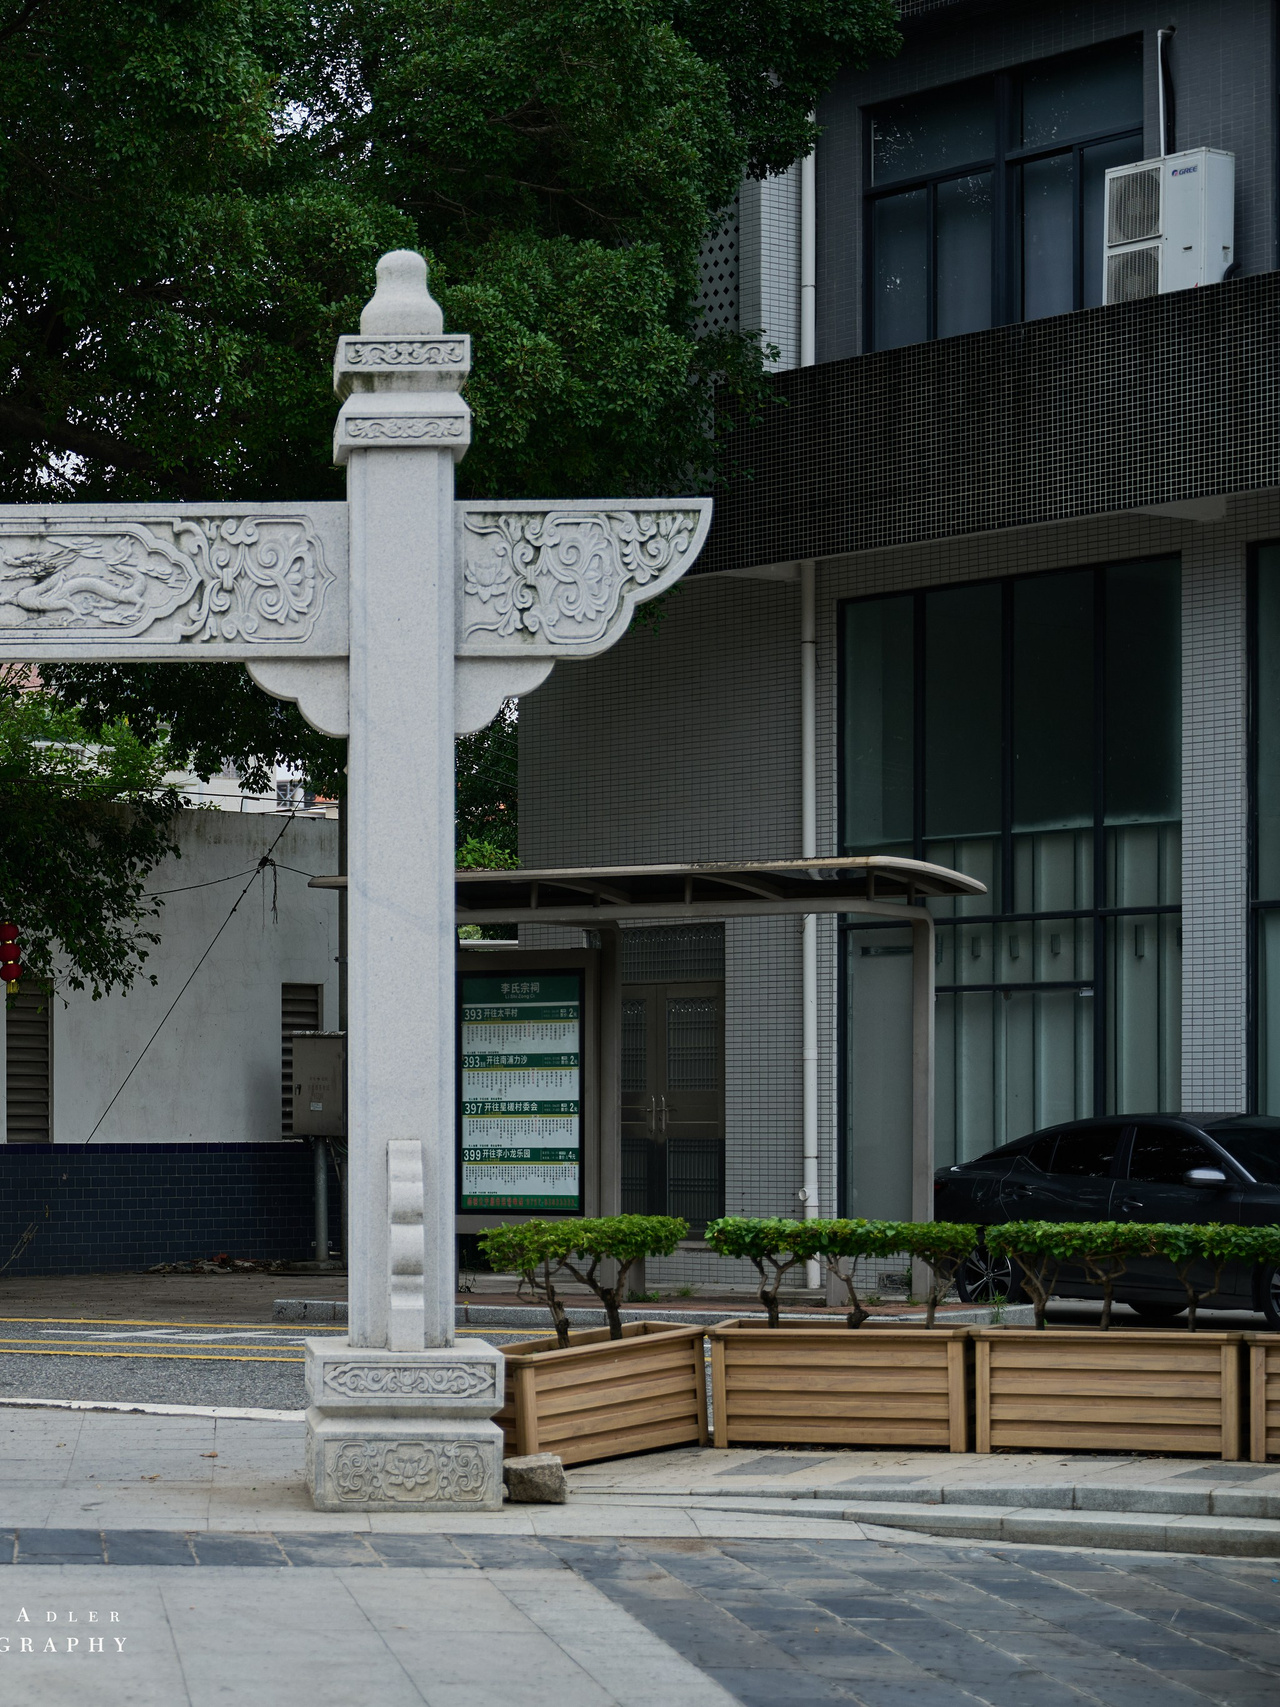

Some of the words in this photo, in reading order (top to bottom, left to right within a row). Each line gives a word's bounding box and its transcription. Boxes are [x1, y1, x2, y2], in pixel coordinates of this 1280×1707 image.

[1179, 165, 1198, 175] GREE
[500, 982, 540, 994] 李氏宗祠
[464, 1009, 482, 1020] 393
[483, 1008, 518, 1018] 开往太平村
[463, 1056, 480, 1067] 393
[464, 1103, 482, 1114] 397
[463, 1149, 481, 1160] 399
[482, 1149, 531, 1158] 开往李小龙乐园
